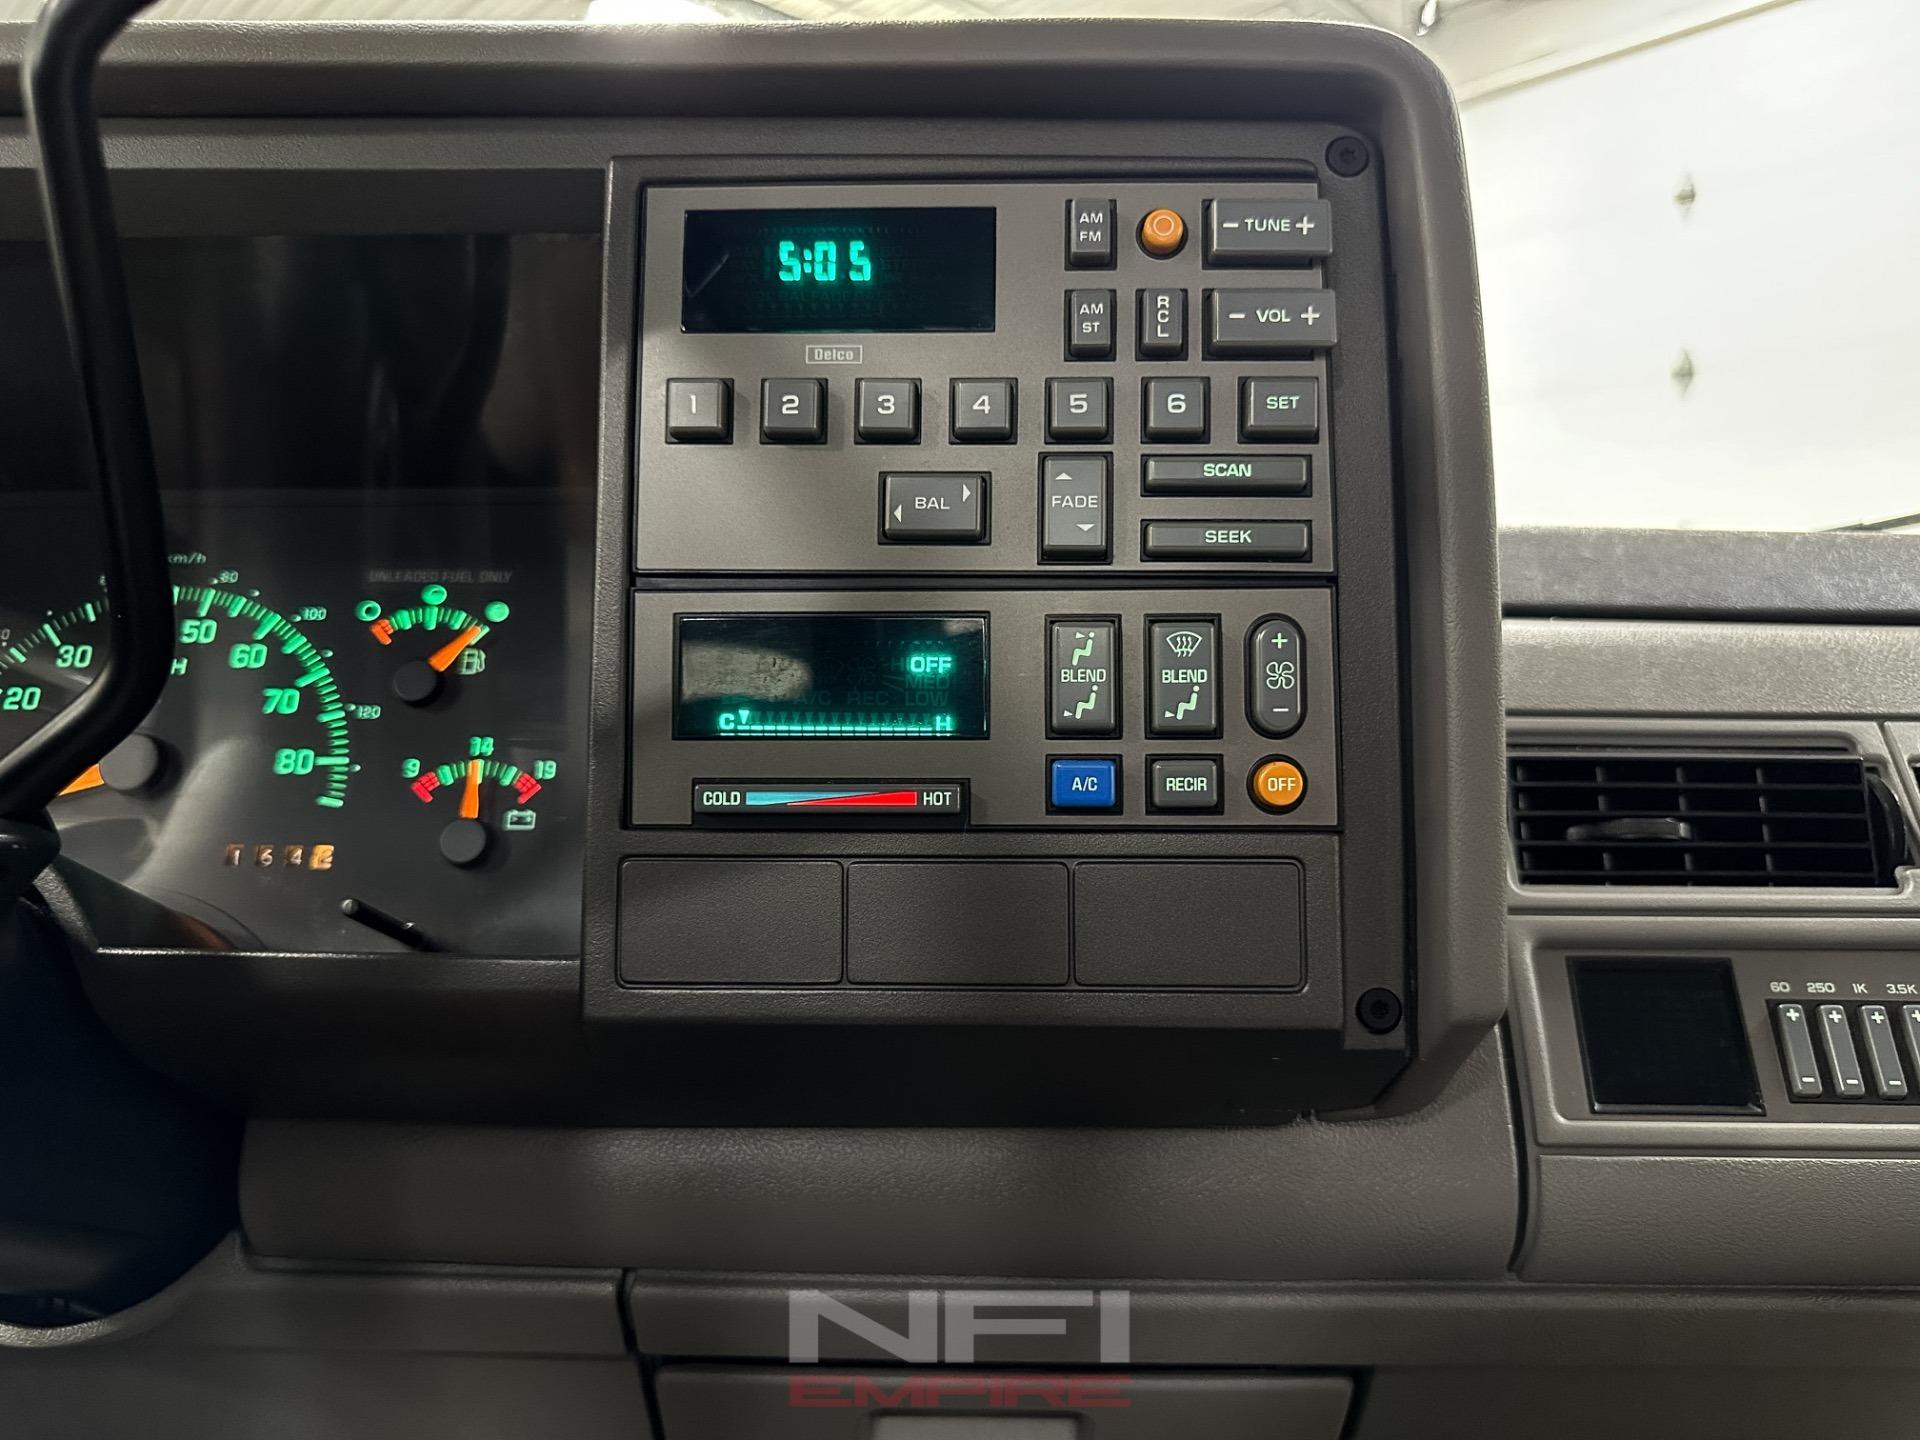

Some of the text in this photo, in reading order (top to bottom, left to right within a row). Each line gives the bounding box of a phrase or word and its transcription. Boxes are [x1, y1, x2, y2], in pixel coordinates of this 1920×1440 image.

[1079, 213, 1103, 224] AM
[1244, 219, 1291, 232] TUNE
[1079, 231, 1102, 242] FM
[1079, 303, 1104, 315] AM
[1256, 309, 1291, 323] VOL
[1082, 322, 1101, 333] ST
[814, 347, 855, 362] Delco
[689, 395, 697, 414] 1
[781, 395, 800, 415] 2
[877, 395, 896, 415] 3
[972, 395, 991, 415] 4
[1069, 394, 1088, 414] 5
[1167, 394, 1187, 414] 6
[1266, 396, 1299, 409] SET
[1203, 463, 1252, 478] SCAN
[915, 496, 950, 510] BAL
[1051, 495, 1098, 508] FADE
[1204, 529, 1252, 544] SEEK
[218, 570, 239, 583] 80
[367, 569, 513, 584] UNLEADED FUEL ONLY
[302, 606, 328, 621] 100
[179, 618, 218, 643] 50
[56, 645, 93, 668] 30
[229, 643, 268, 669] 60
[909, 656, 953, 674] OFF
[1061, 669, 1107, 683] BLEND
[1161, 669, 1208, 684] BLEND
[3, 687, 42, 710] 20
[262, 688, 301, 714] 70
[356, 704, 381, 720] 120
[718, 713, 735, 730] C
[935, 715, 953, 731] H
[469, 736, 495, 756] 14
[273, 749, 315, 775] 80
[402, 758, 421, 778] 9
[534, 760, 557, 780] 19
[1071, 776, 1098, 792] A/C
[1166, 777, 1208, 792] RECIR
[1267, 777, 1296, 792] OFF
[703, 791, 741, 807] COLD
[923, 791, 952, 807] HOT
[1770, 981, 1791, 993] 60
[1806, 982, 1837, 993] 250
[1852, 983, 1869, 994] 1K
[1886, 984, 1918, 995] 3.5K
